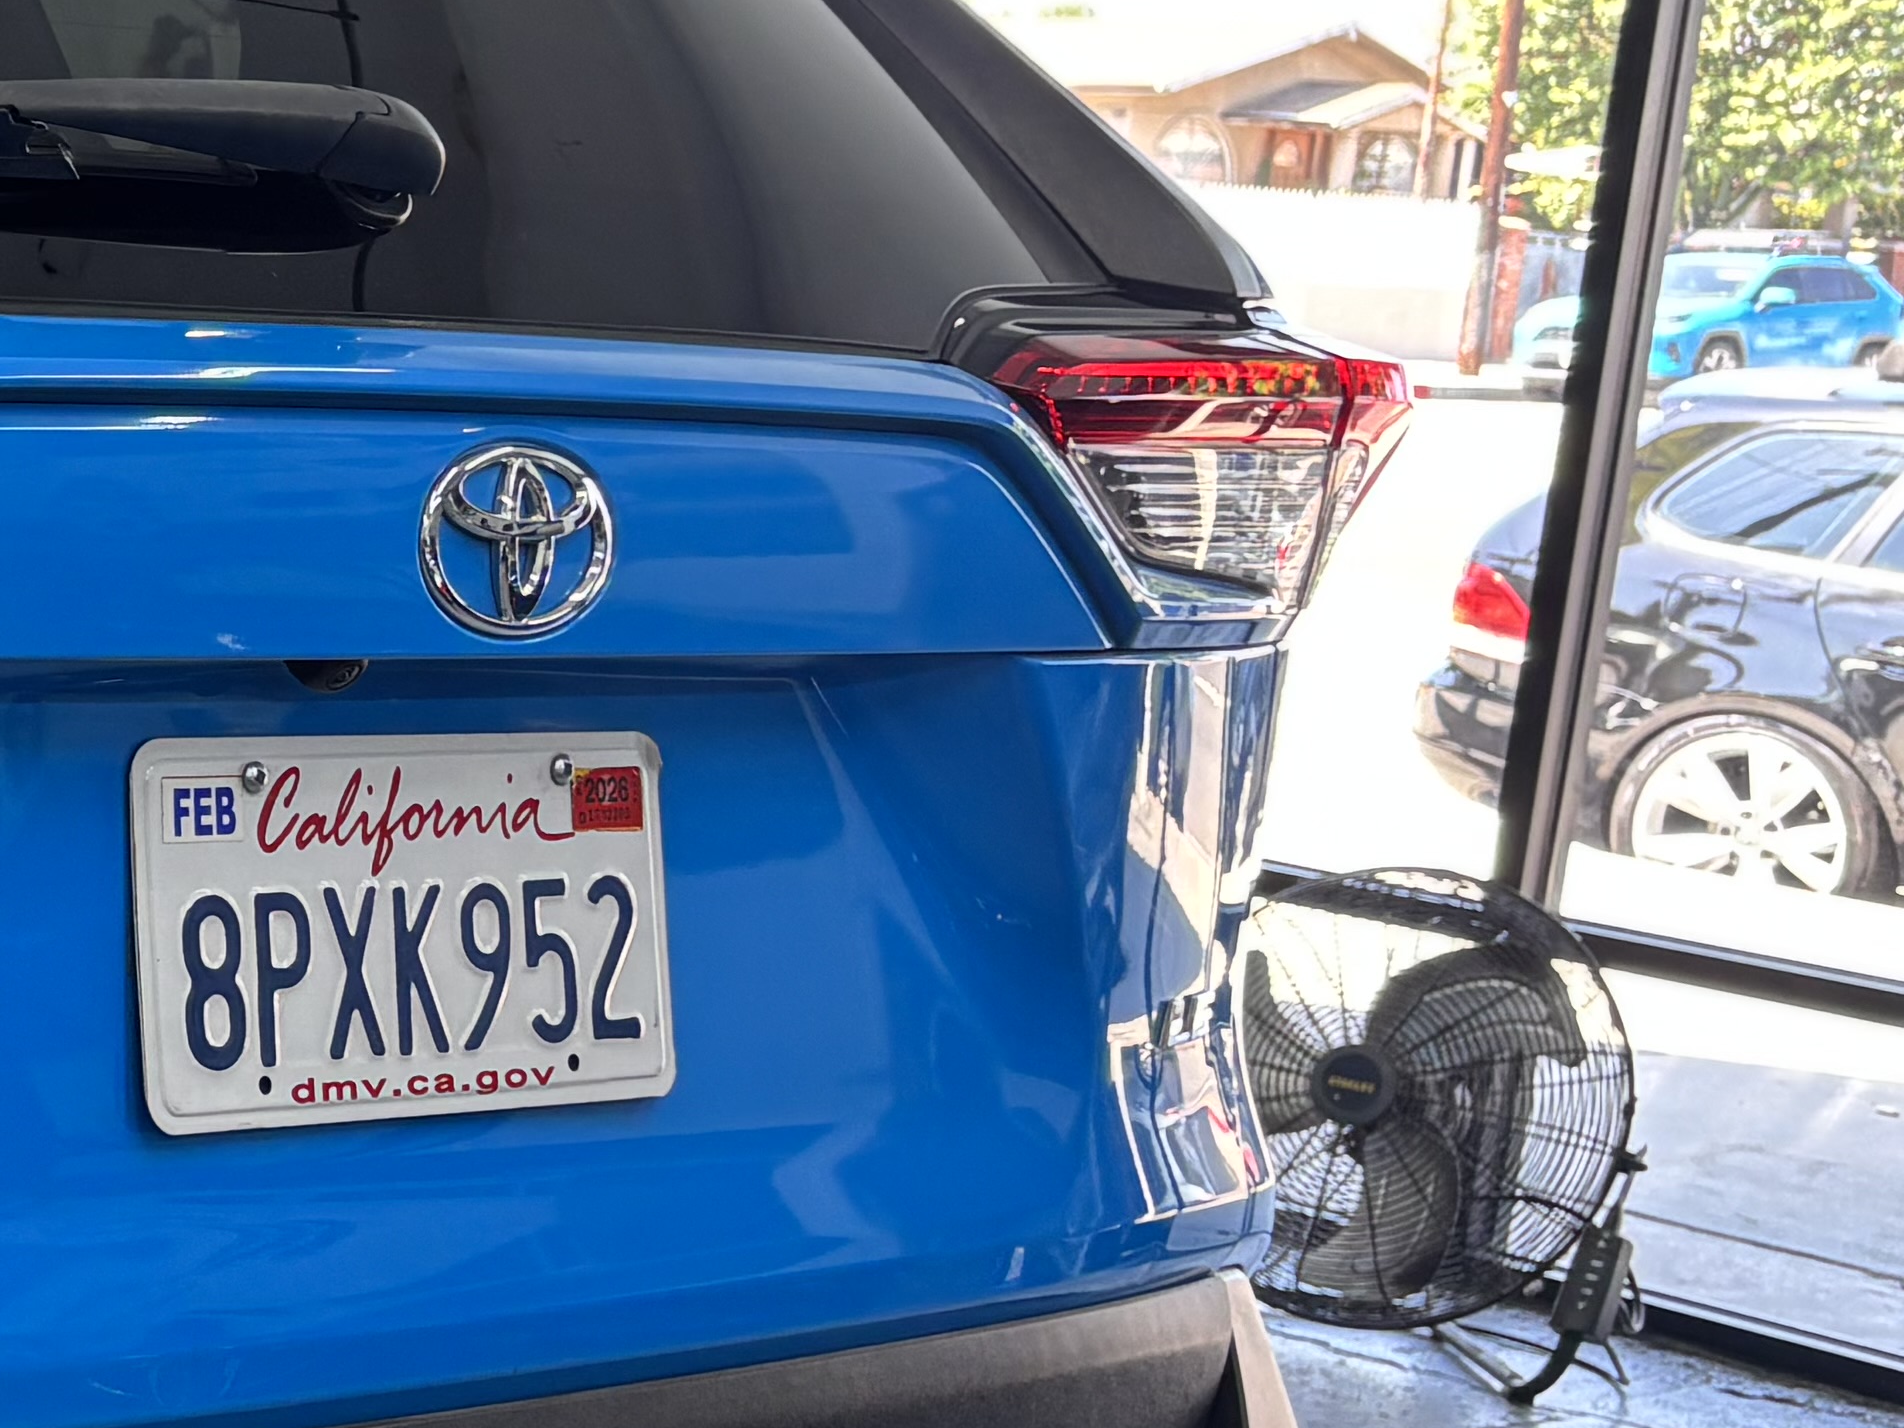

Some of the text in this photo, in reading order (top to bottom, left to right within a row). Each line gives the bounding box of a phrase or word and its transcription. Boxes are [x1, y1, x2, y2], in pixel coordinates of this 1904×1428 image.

[173, 787, 237, 837] FEB
[584, 775, 630, 803] 2026
[256, 765, 576, 876] California
[181, 875, 643, 1071] 8PXK952
[291, 1065, 556, 1104] dmv.ca.gov
